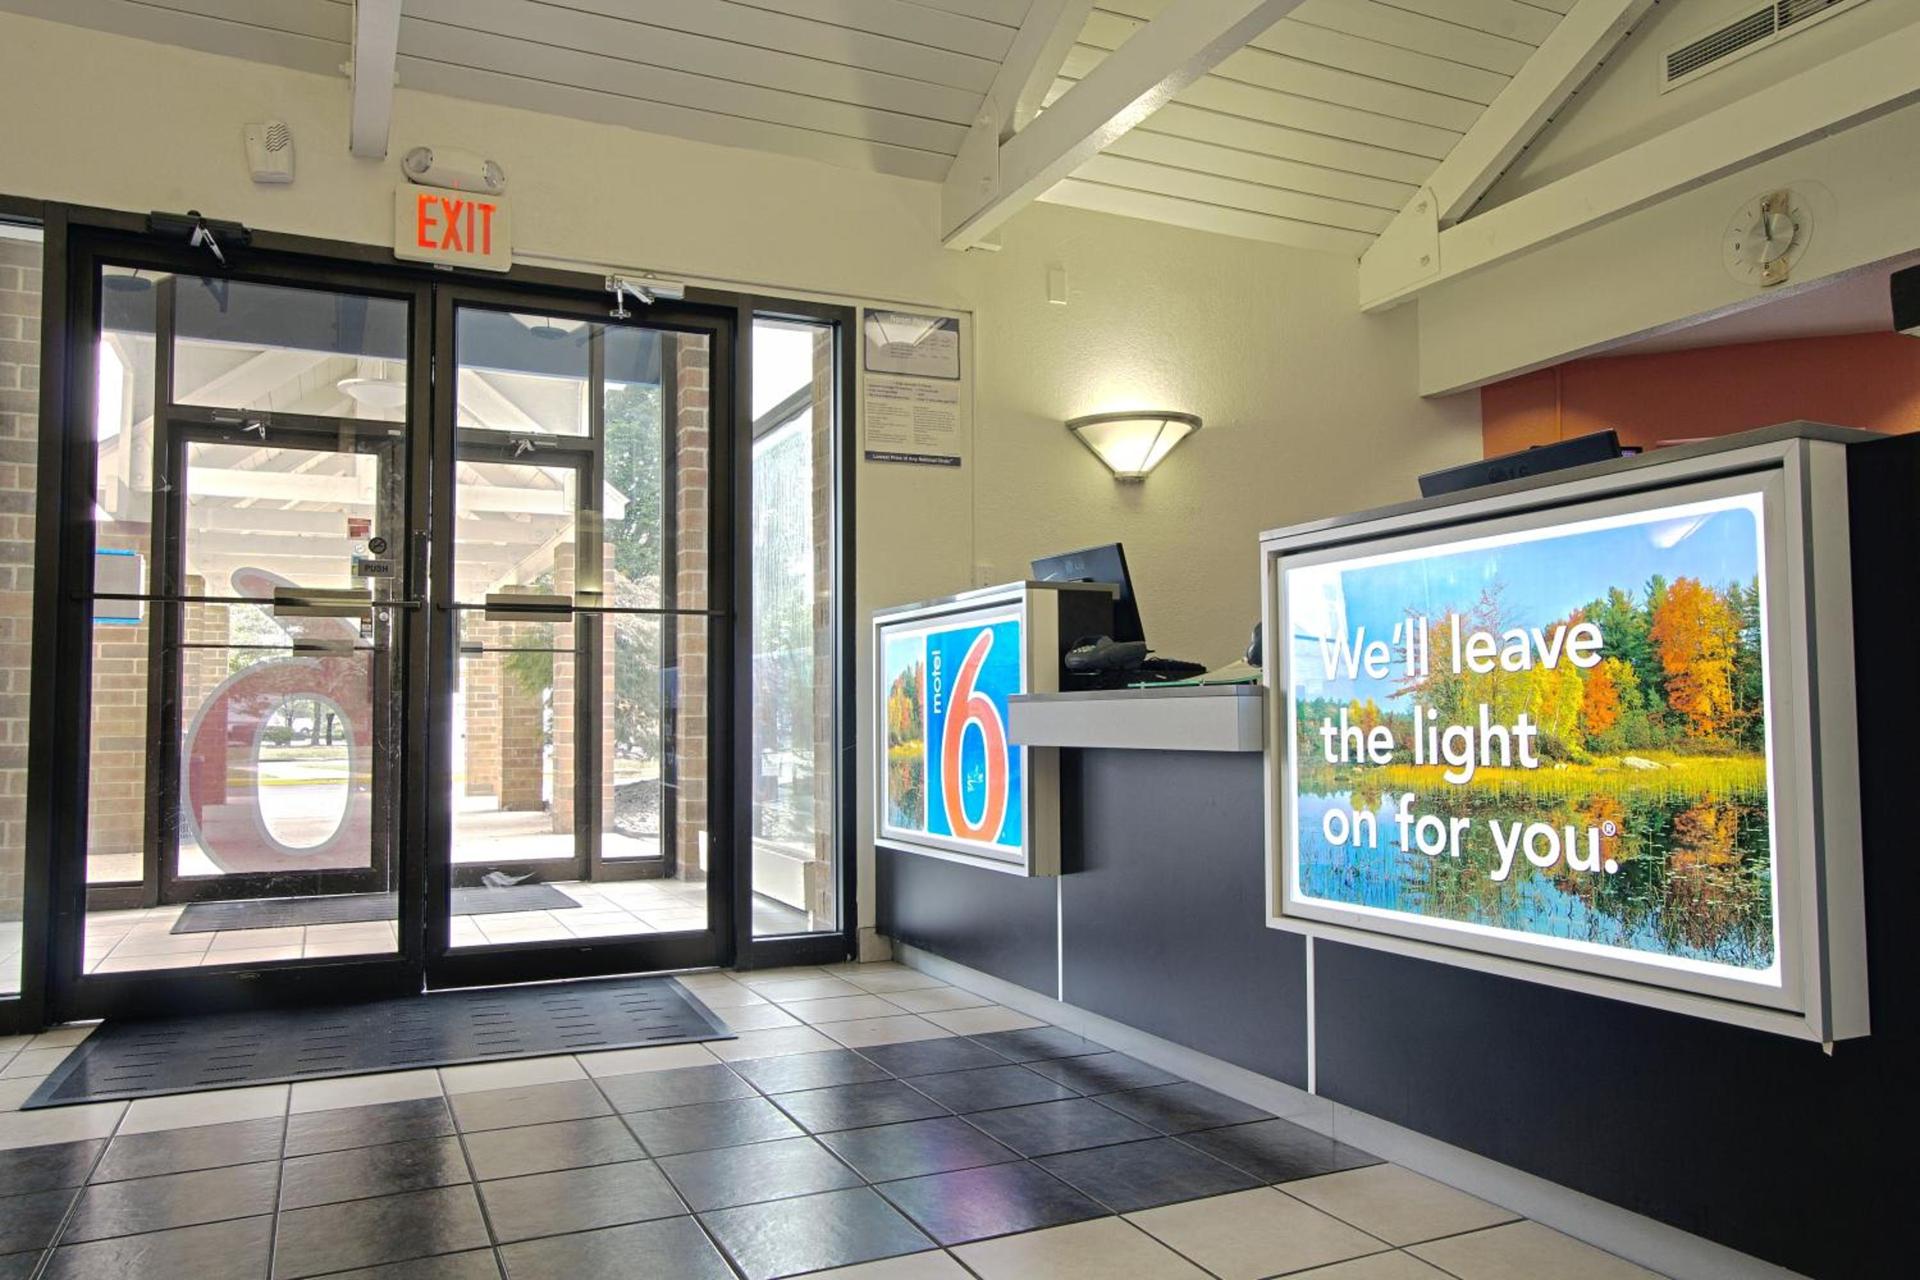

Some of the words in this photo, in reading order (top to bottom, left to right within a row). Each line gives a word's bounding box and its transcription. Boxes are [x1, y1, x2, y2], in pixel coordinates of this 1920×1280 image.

[417, 193, 496, 255] EXIT
[365, 564, 389, 573] PUSH
[1319, 616, 1429, 681] We'll
[1451, 614, 1603, 676] leave
[931, 649, 942, 714] motel
[941, 627, 1010, 843] 6
[1319, 709, 1395, 767] the
[1414, 703, 1539, 785] light
[1322, 808, 1377, 849] on
[1395, 793, 1471, 858] for
